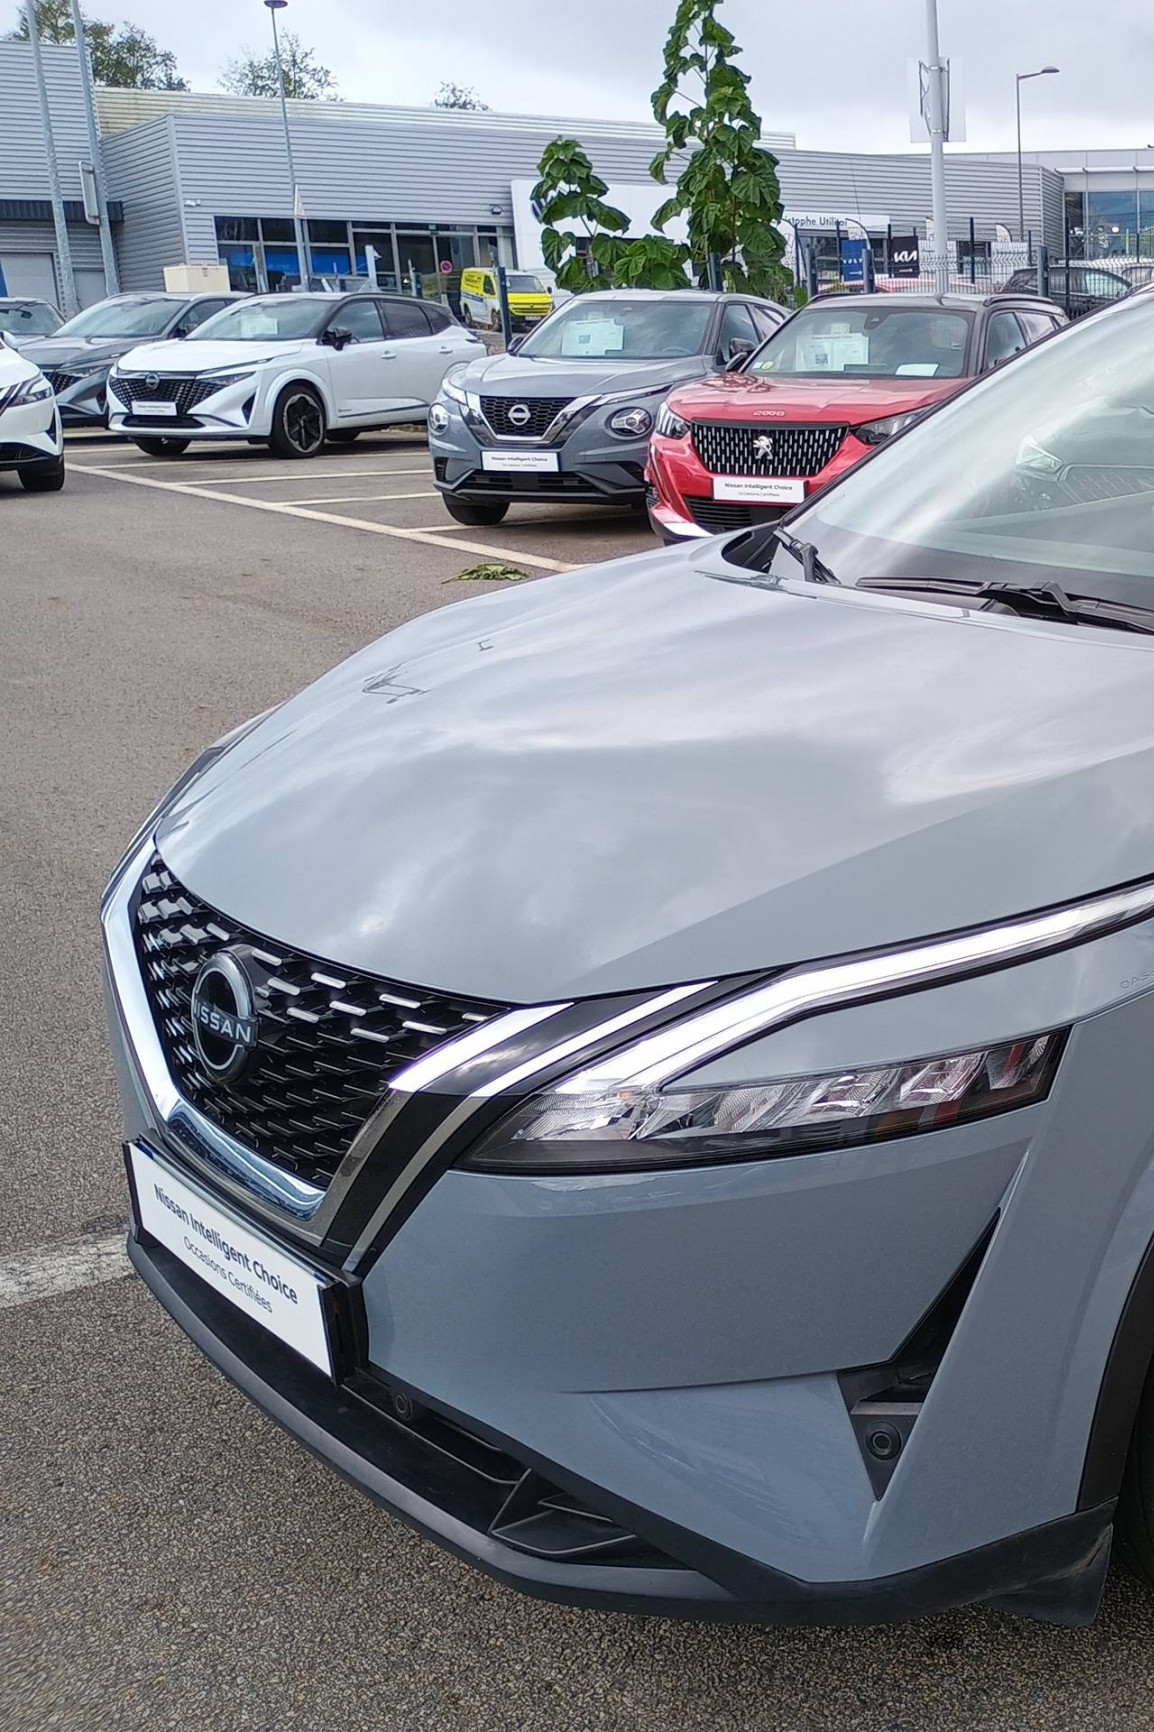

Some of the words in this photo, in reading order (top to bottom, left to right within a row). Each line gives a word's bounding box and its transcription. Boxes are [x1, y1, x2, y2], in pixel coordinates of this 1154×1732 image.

[154, 1183, 190, 1226] Nissan
[191, 1211, 252, 1272] Intelligent
[253, 1260, 298, 1305] Choice
[183, 1236, 227, 1280] Occasions
[228, 1270, 273, 1314] Certifiées
